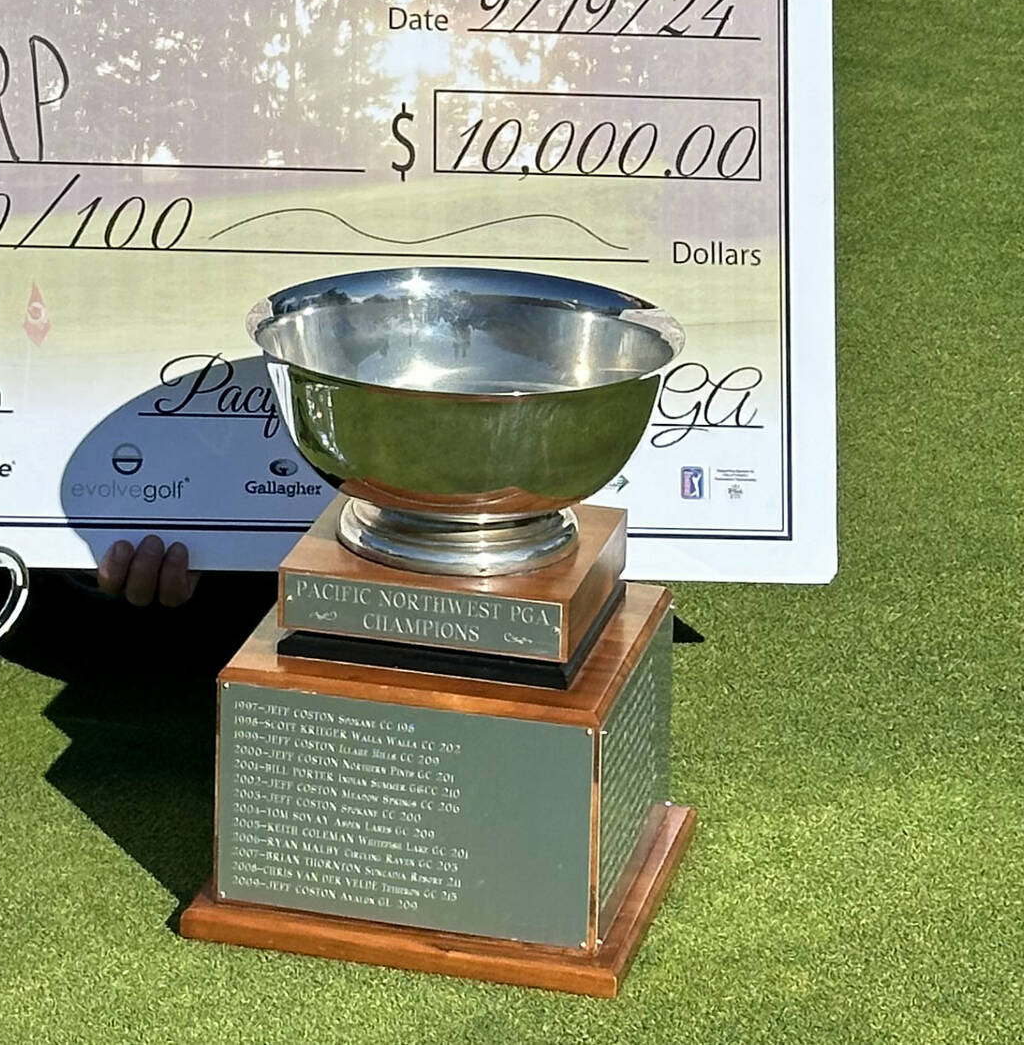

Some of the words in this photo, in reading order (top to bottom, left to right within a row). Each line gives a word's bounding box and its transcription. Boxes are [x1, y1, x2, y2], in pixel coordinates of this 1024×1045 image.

[388, 7, 449, 32] Date
[391, 102, 415, 182] $
[451, 117, 758, 181] 10,000.00
[672, 241, 762, 267] Dollars
[71, 479, 185, 503] evolvegolf
[244, 481, 322, 497] Gallagher
[296, 579, 372, 605] PACIFIC
[378, 589, 503, 621] NORTHWEST
[510, 606, 551, 627] PGA
[362, 612, 480, 643] CHAMPIONS
[294, 709, 334, 723] COSTON
[379, 719, 393, 731] CC
[294, 738, 335, 753] COSTON
[400, 752, 414, 763] CC
[300, 724, 347, 739] KRIEGER
[421, 740, 435, 752] CC
[293, 766, 334, 782] PORTER
[297, 754, 338, 767] COSTON
[417, 769, 432, 780] GC
[296, 783, 337, 797] COSTON
[420, 800, 435, 811] CC
[296, 798, 337, 811] COSTON
[382, 809, 395, 820] CC
[302, 827, 354, 843] COLEMAN
[431, 845, 446, 856] GC
[296, 870, 318, 882] VAN
[418, 859, 433, 870] GC
[295, 885, 337, 899] COSTON
